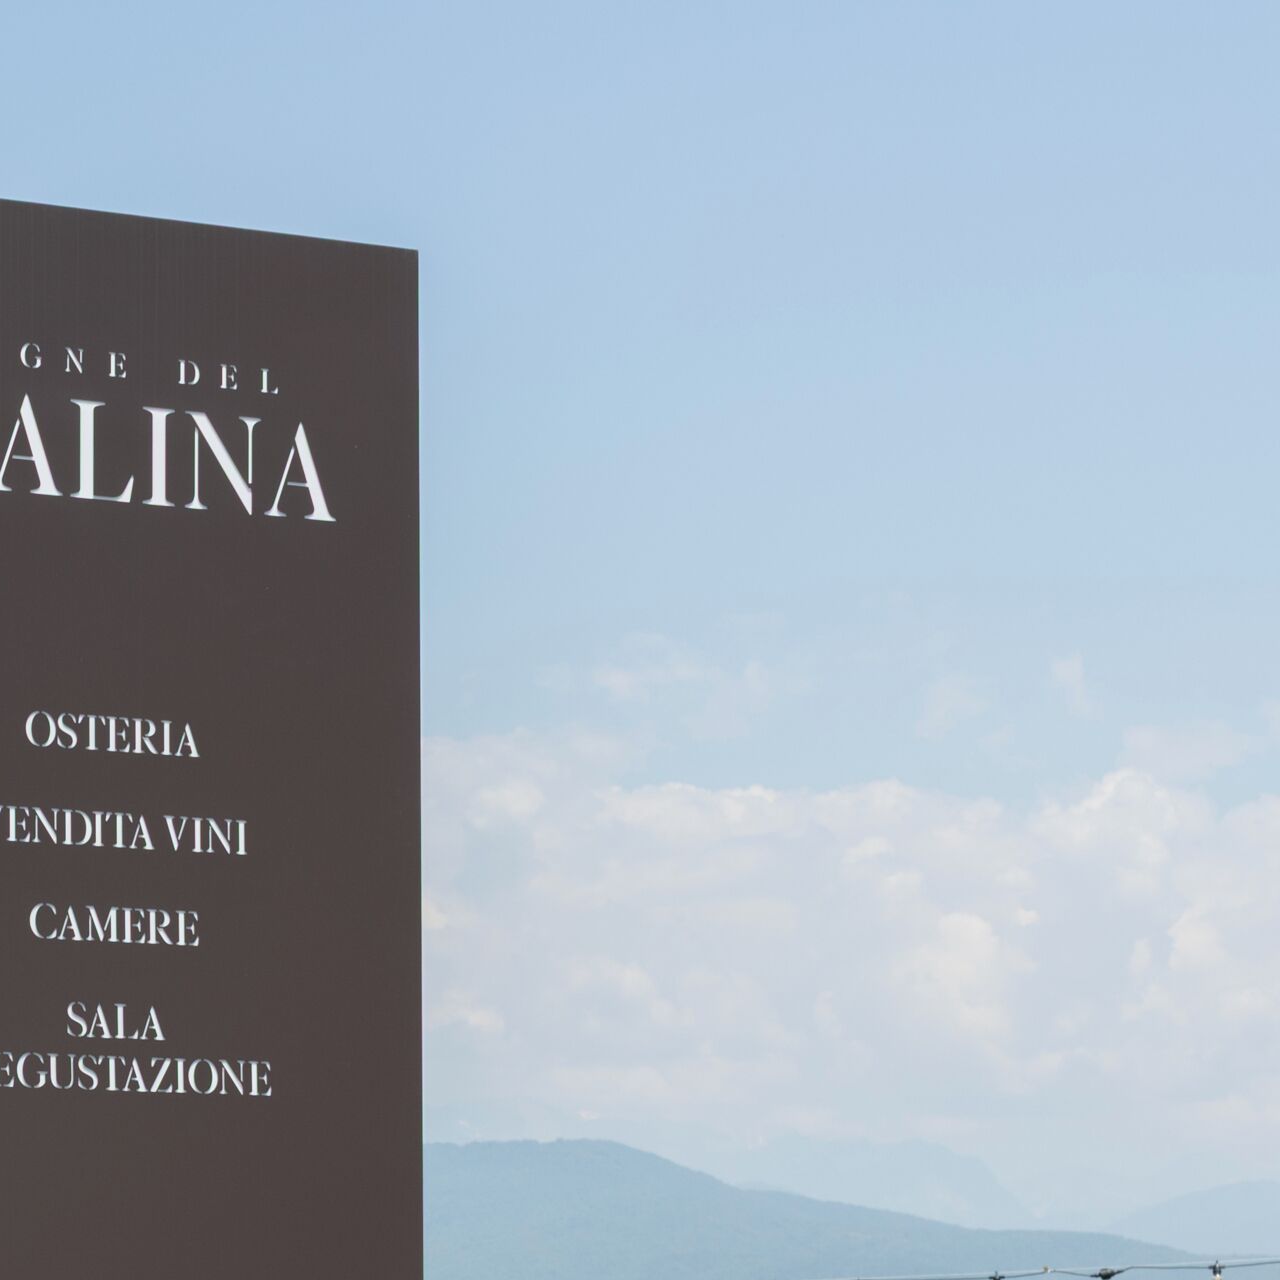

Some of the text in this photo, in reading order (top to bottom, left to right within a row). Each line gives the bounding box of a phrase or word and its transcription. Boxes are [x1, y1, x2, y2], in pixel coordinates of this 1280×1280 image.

[178, 359, 279, 395] DEL
[25, 710, 200, 758] OSTERIA
[163, 815, 248, 856] VINI
[29, 903, 200, 946] CAMERE
[65, 1002, 166, 1041] SALA
